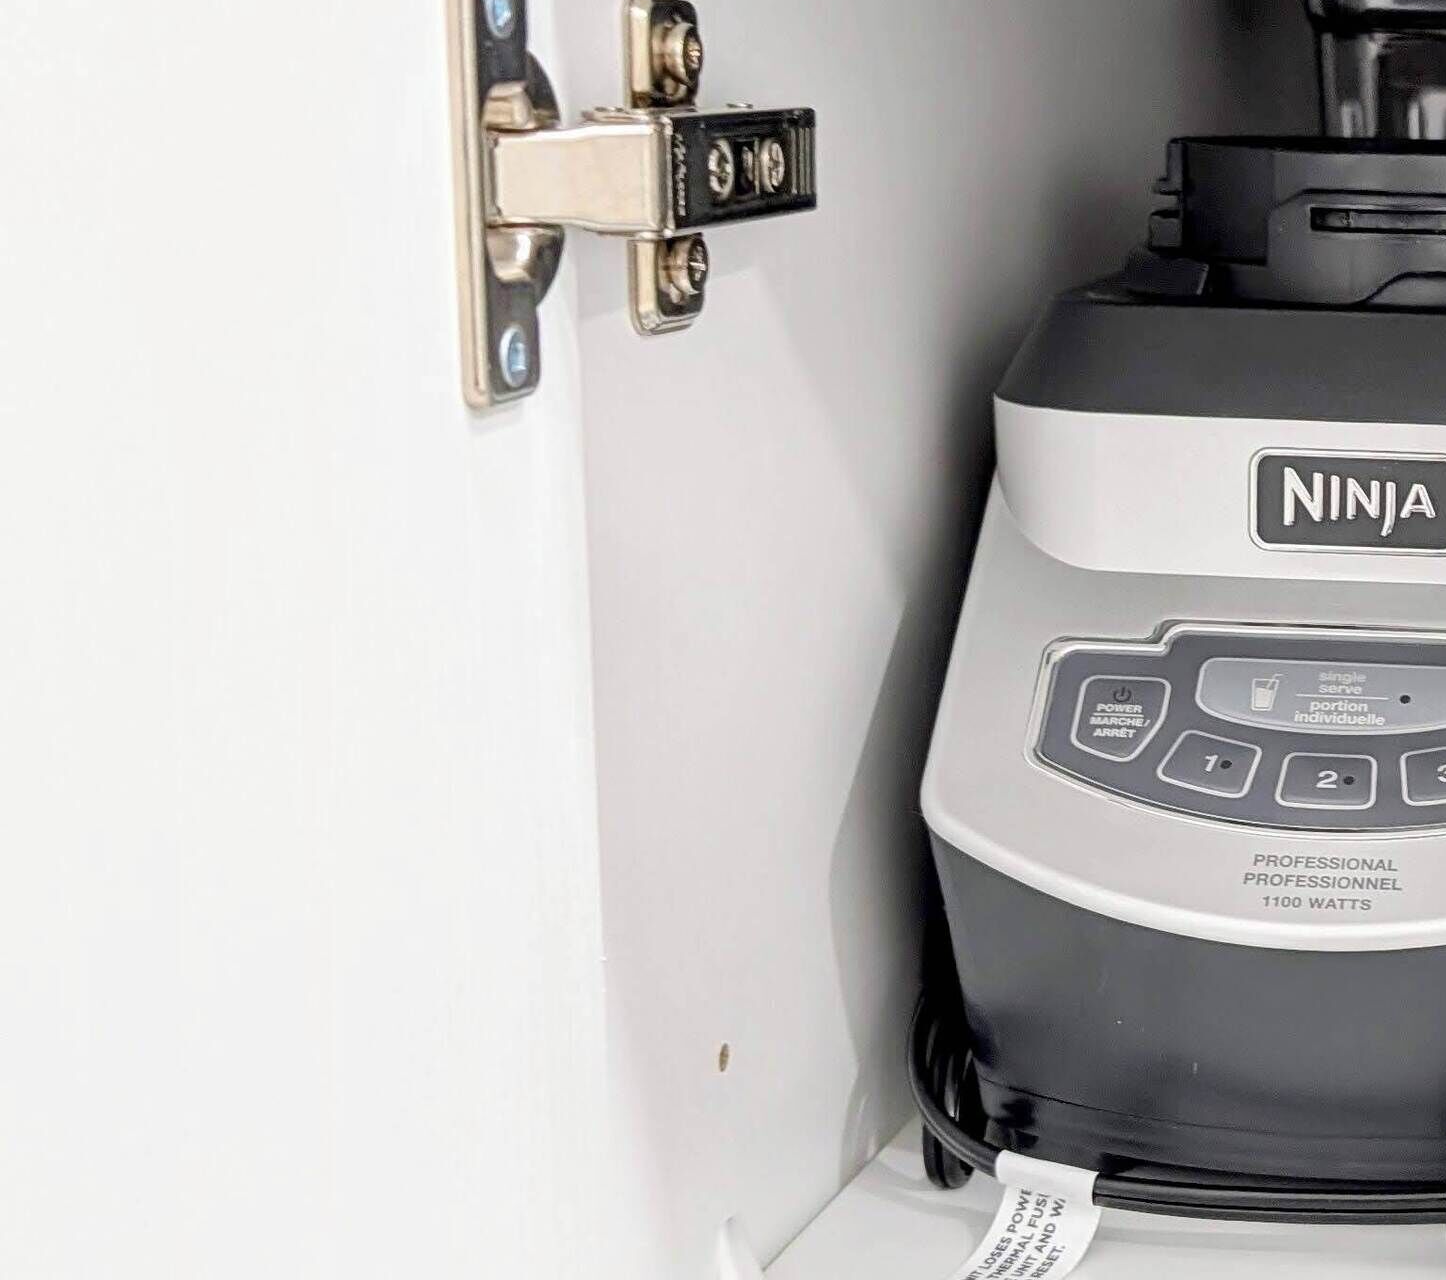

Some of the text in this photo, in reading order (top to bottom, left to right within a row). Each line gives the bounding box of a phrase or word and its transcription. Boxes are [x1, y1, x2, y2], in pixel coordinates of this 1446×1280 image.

[1282, 466, 1437, 538] NINJA
[1318, 671, 1367, 685] single
[1318, 684, 1363, 695] serve
[1096, 703, 1143, 713] POWER
[1310, 700, 1368, 713] portion
[1294, 711, 1386, 726] individuelle
[1092, 727, 1137, 738] ARRÊT
[1204, 754, 1218, 772] 1
[1316, 770, 1338, 789] 2
[1252, 853, 1399, 872] PROFESSIONAL
[1243, 872, 1403, 891] PROFESSIONNEL
[1262, 895, 1372, 911] 1100 WATTS
[978, 1236, 1012, 1270] LOSES
[986, 1232, 1035, 1279] THERMAL
[1013, 1254, 1038, 1277] UNIT
[1034, 1222, 1056, 1253] AND
[1030, 1245, 1066, 1278] RESET.
